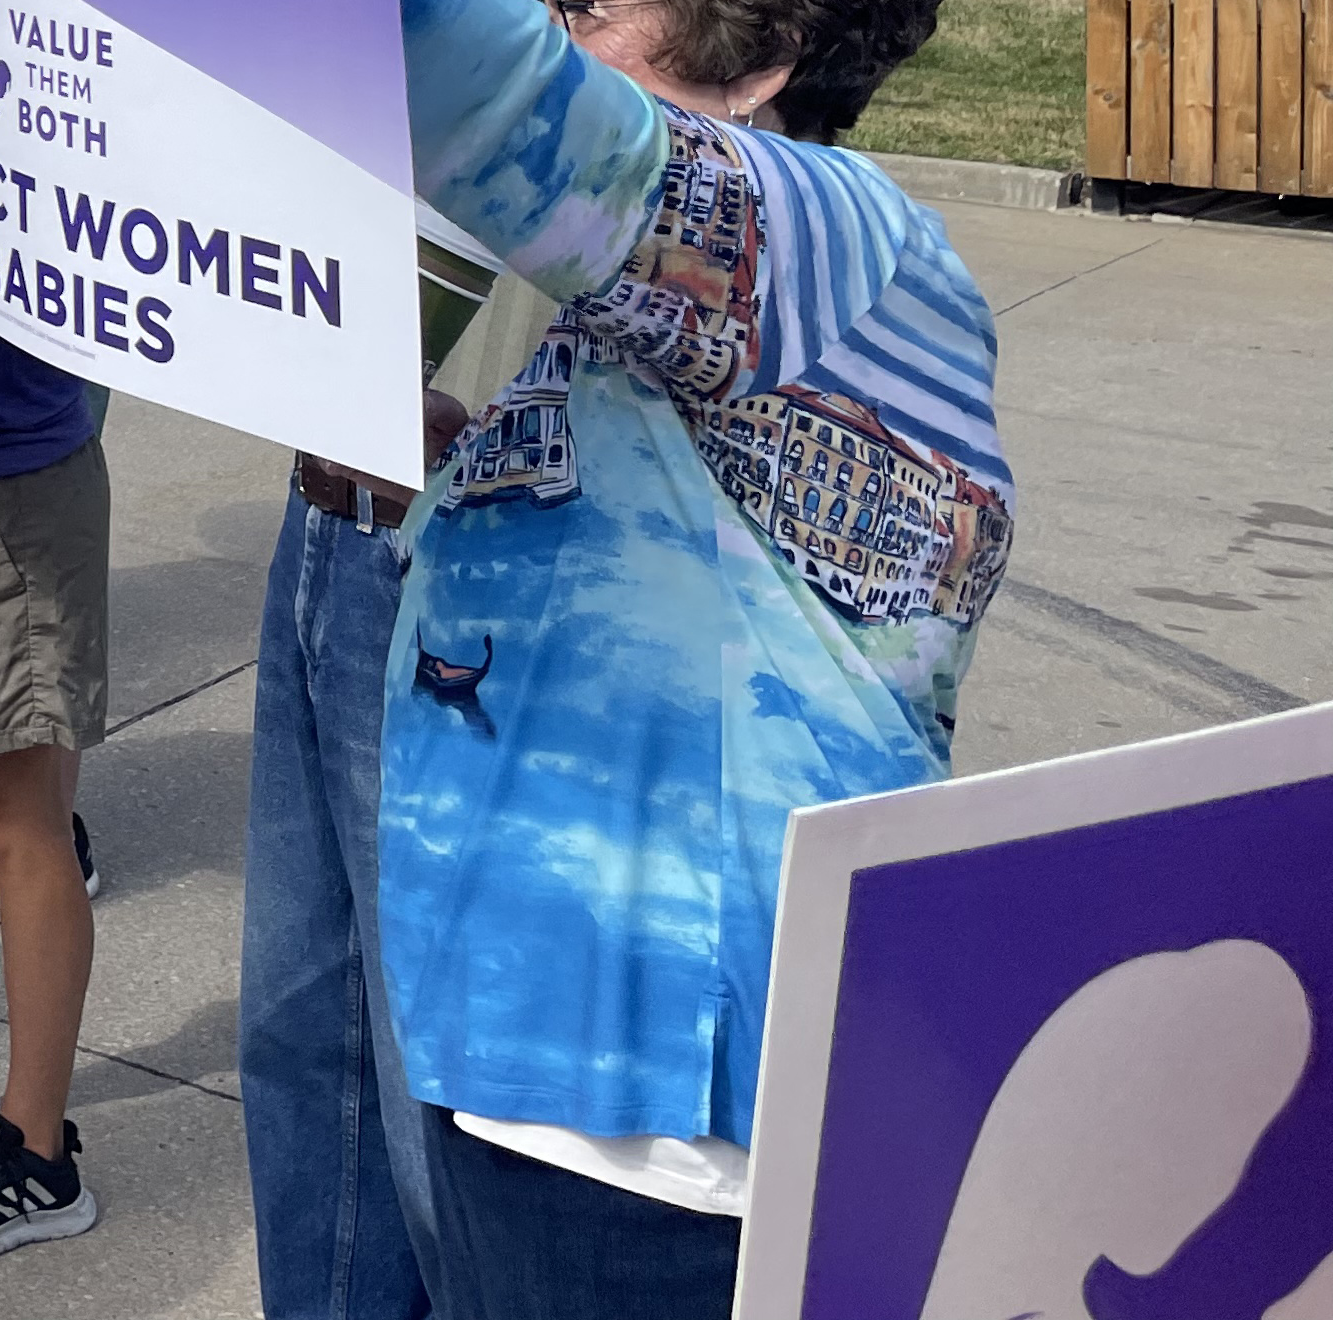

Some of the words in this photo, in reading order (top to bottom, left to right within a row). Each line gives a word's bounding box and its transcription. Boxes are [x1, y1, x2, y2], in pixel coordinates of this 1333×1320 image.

[8, 8, 114, 68] VALUE
[25, 61, 92, 104] THEM
[18, 97, 107, 158] BOTH
[53, 185, 342, 330] WOMEN
